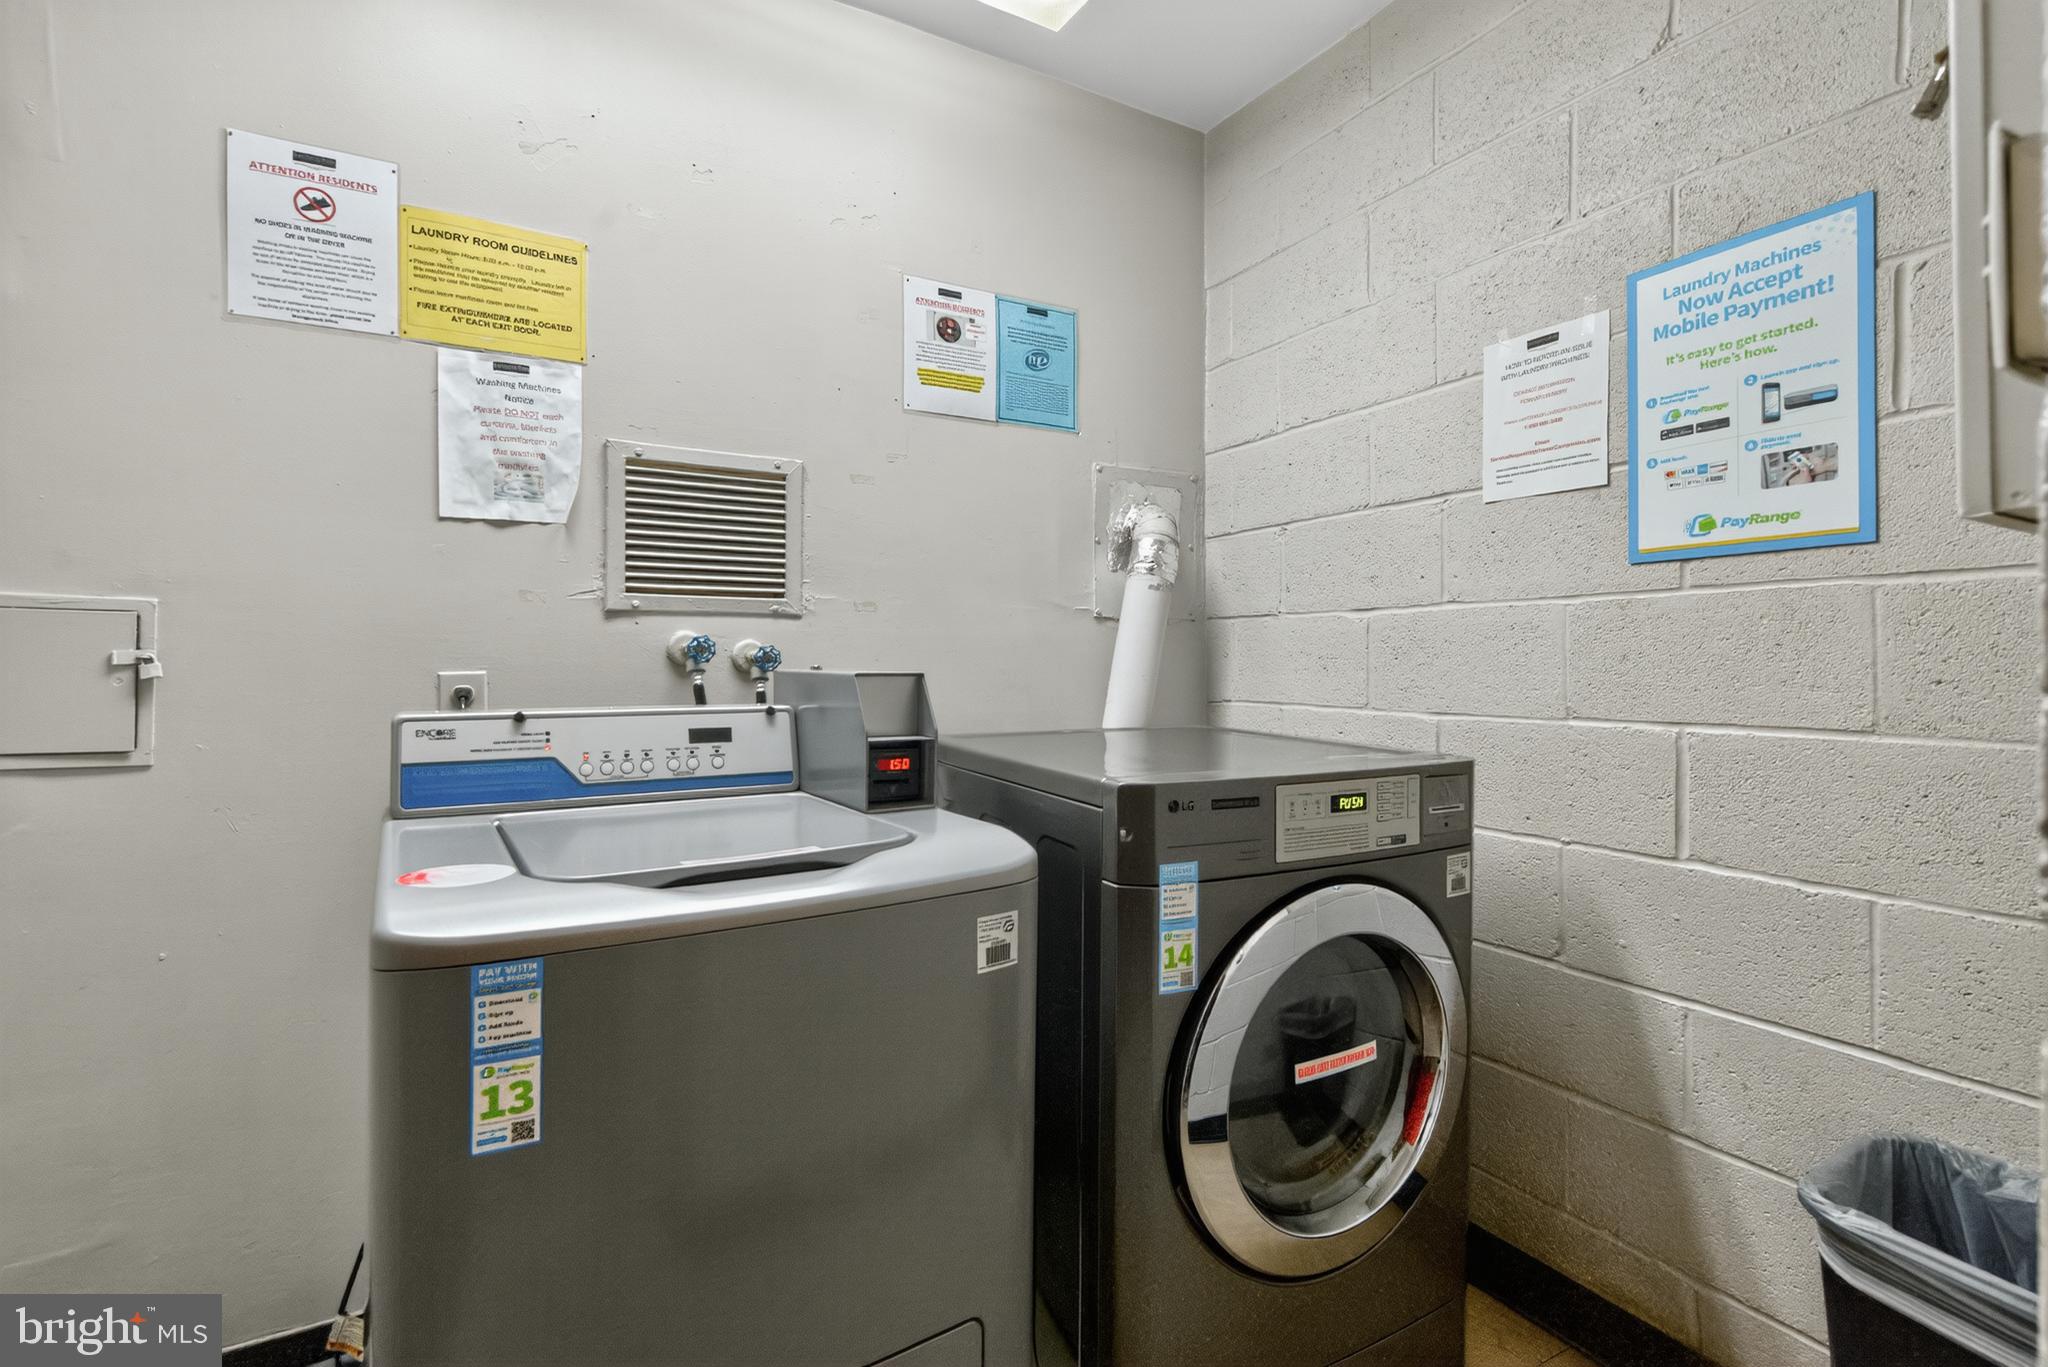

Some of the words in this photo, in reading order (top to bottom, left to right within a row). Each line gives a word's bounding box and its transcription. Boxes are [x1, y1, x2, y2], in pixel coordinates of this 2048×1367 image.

[250, 160, 315, 182] ATTENTION
[319, 174, 377, 194] RESIDENTS
[411, 224, 469, 243] LAUNDRY
[473, 237, 508, 252] ROOM
[512, 245, 578, 266] GUIDELINES
[1663, 269, 1731, 301] Laundry
[1735, 240, 1822, 277] Machines
[1678, 290, 1724, 315] Now
[1728, 263, 1803, 300] Accept
[416, 301, 437, 311] FIRE
[440, 304, 511, 323] EXTINGUISHERS
[513, 317, 530, 325] ARE
[533, 320, 572, 333] LOCATED
[1653, 312, 1719, 342] Mobile
[1724, 275, 1835, 321] Payment!
[452, 315, 463, 323] AT
[466, 318, 490, 328] EACH
[492, 322, 512, 331] EXIT
[1666, 352, 1684, 366] It's
[1687, 345, 1717, 362] easy
[1719, 339, 1733, 352] to
[1736, 333, 1758, 351] get
[1760, 317, 1818, 341] started.
[1700, 351, 1741, 370] Here's
[1744, 343, 1778, 360] how.
[476, 377, 516, 389] Washing
[518, 382, 562, 394] Machines
[505, 408, 519, 418] DO
[521, 410, 539, 420] NOT
[1720, 510, 1801, 530] PayRange
[415, 729, 456, 738] ENCORE
[1181, 800, 1194, 811] LG
[1340, 796, 1363, 809] PUSH
[1164, 943, 1193, 970] 14
[480, 1079, 534, 1121] 13
